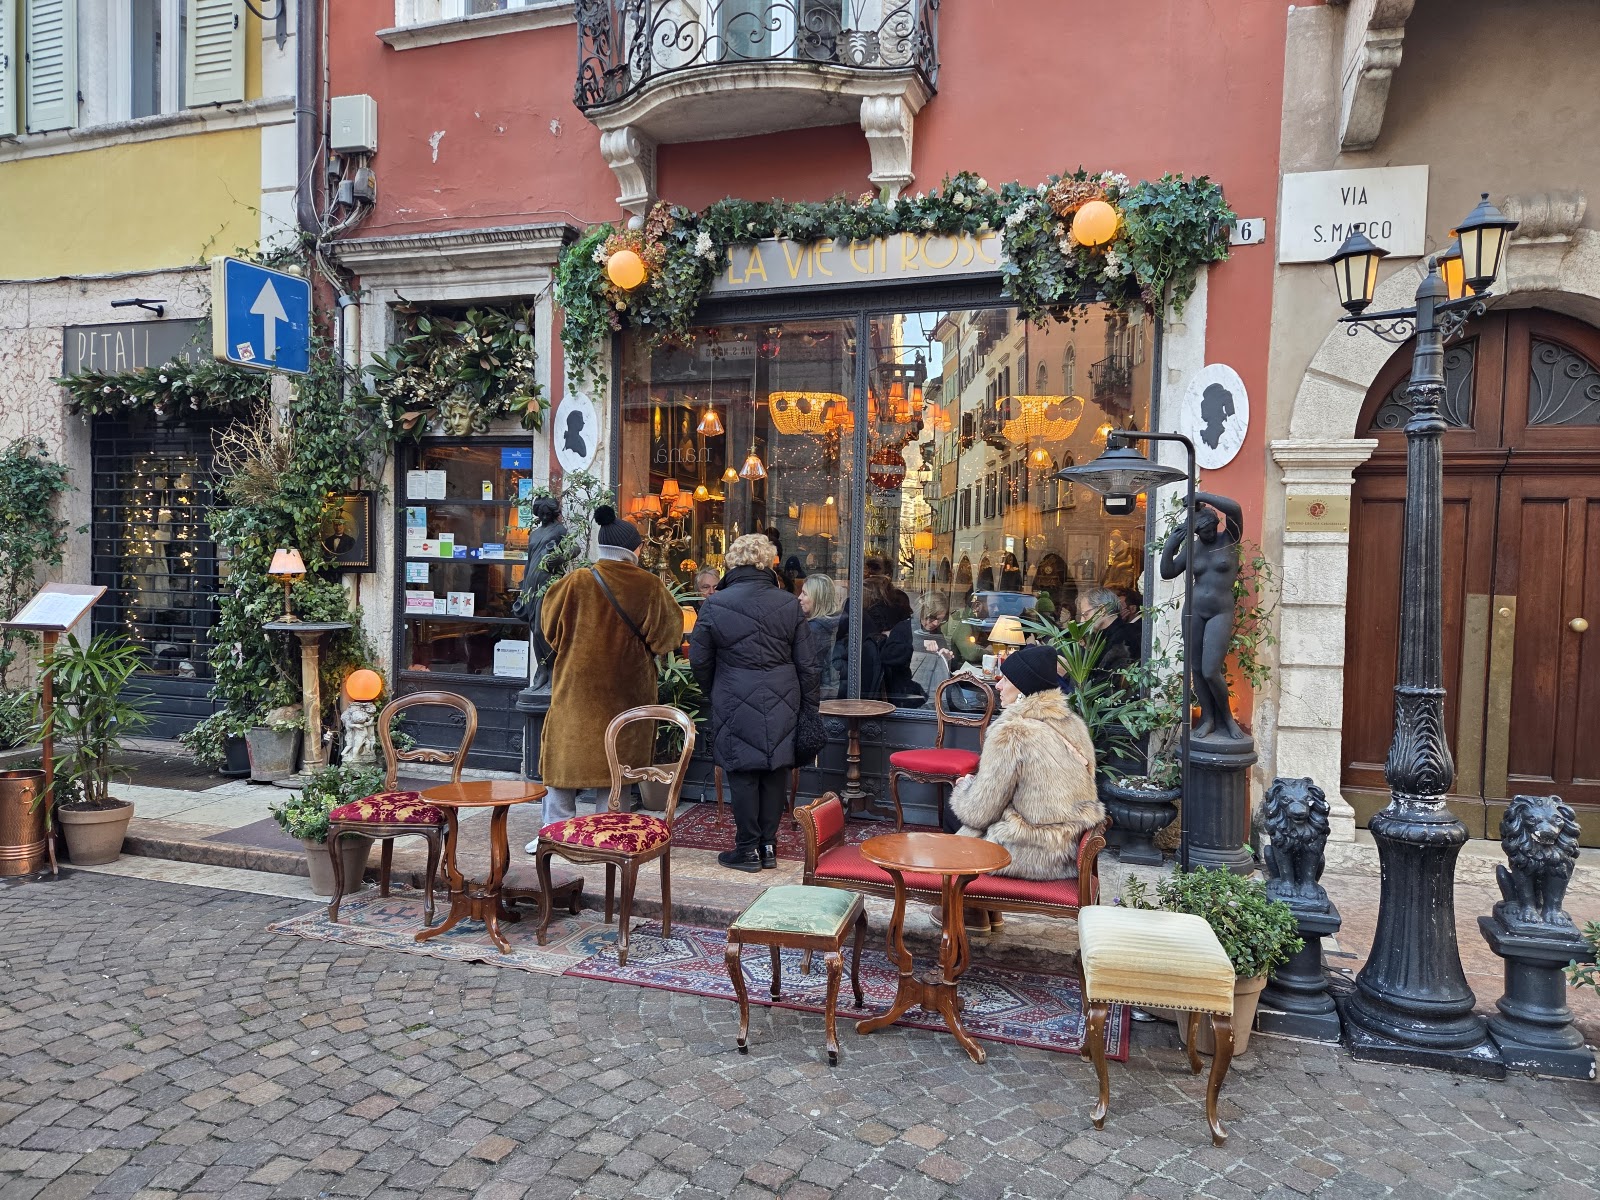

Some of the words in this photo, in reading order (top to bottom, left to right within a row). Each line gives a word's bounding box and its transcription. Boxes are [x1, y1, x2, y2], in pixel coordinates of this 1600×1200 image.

[1341, 186, 1368, 205] VIA
[1241, 221, 1252, 241] 6
[728, 246, 768, 285] LA
[781, 238, 833, 279] VIE
[901, 228, 996, 271] ROSE
